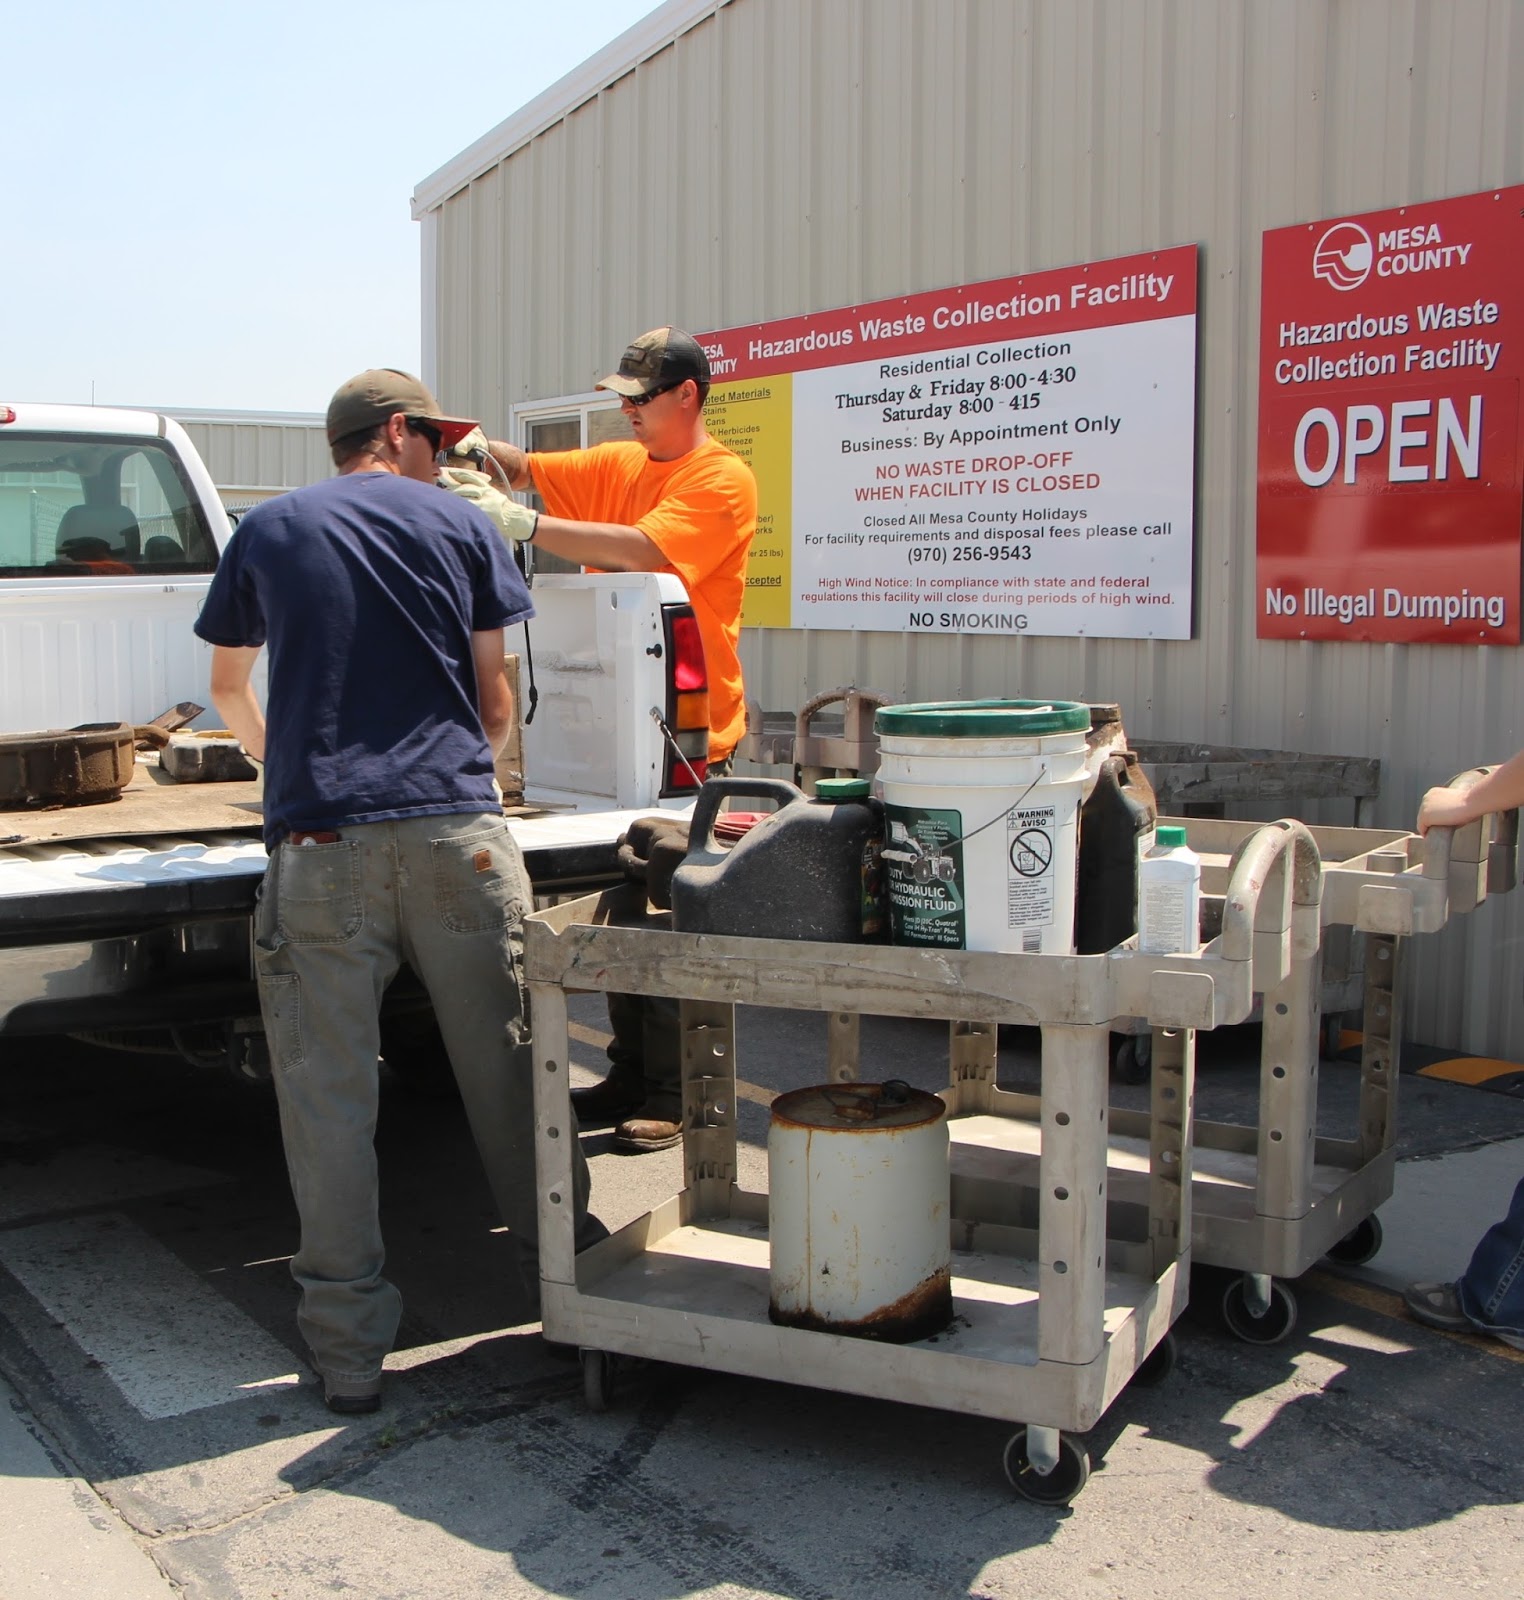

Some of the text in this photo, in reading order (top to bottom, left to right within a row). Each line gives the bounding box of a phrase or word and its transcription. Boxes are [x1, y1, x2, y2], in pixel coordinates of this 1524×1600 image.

[1378, 223, 1441, 252] MESA
[1377, 243, 1472, 277] COUNTY
[748, 272, 1174, 360] Hazardous Waste Collection Facility
[1279, 298, 1498, 348] Hazardous Waste
[701, 343, 724, 359] ESA
[709, 358, 737, 376] UNTY
[880, 342, 1071, 379] Residential Collection
[1275, 338, 1501, 385] Collection Facility
[704, 387, 771, 404] pted Materials
[835, 388, 905, 409] Thursday
[909, 384, 922, 400] &
[930, 379, 985, 396] Friday
[702, 406, 727, 416] Stains
[882, 403, 953, 423] Saturday
[959, 397, 994, 415] 8:00
[705, 418, 726, 427] Cans
[717, 424, 760, 436] Herbicides
[719, 437, 753, 447] ntifreeze
[841, 415, 1121, 453] Business: By Appointment Only
[1293, 394, 1482, 487] OPEN
[876, 451, 1073, 480] NO WASTE DROP-OFF
[855, 473, 1100, 502] WHEN FACILITY IS CLOSED
[863, 508, 1088, 527] Closed All Mesa County Holidays
[805, 522, 1172, 545] For facility requirements and disposal fees please call
[759, 549, 768, 557] 25
[769, 549, 784, 558] lbs)
[907, 545, 1032, 565] (970) 256-9543
[744, 575, 782, 585] ccepted
[818, 576, 1150, 590] High Wind Notice: In compliance with state and federal
[801, 591, 1175, 607] regulations this facility will close during periods of high wind.
[1266, 587, 1505, 627] No Illegal Dumping
[909, 612, 1028, 630] NO SMOKING
[1017, 808, 1054, 819] WARNING
[1021, 819, 1047, 828] AVISO
[895, 883, 946, 898] HYDRAULIC
[924, 899, 957, 912] FLUID
